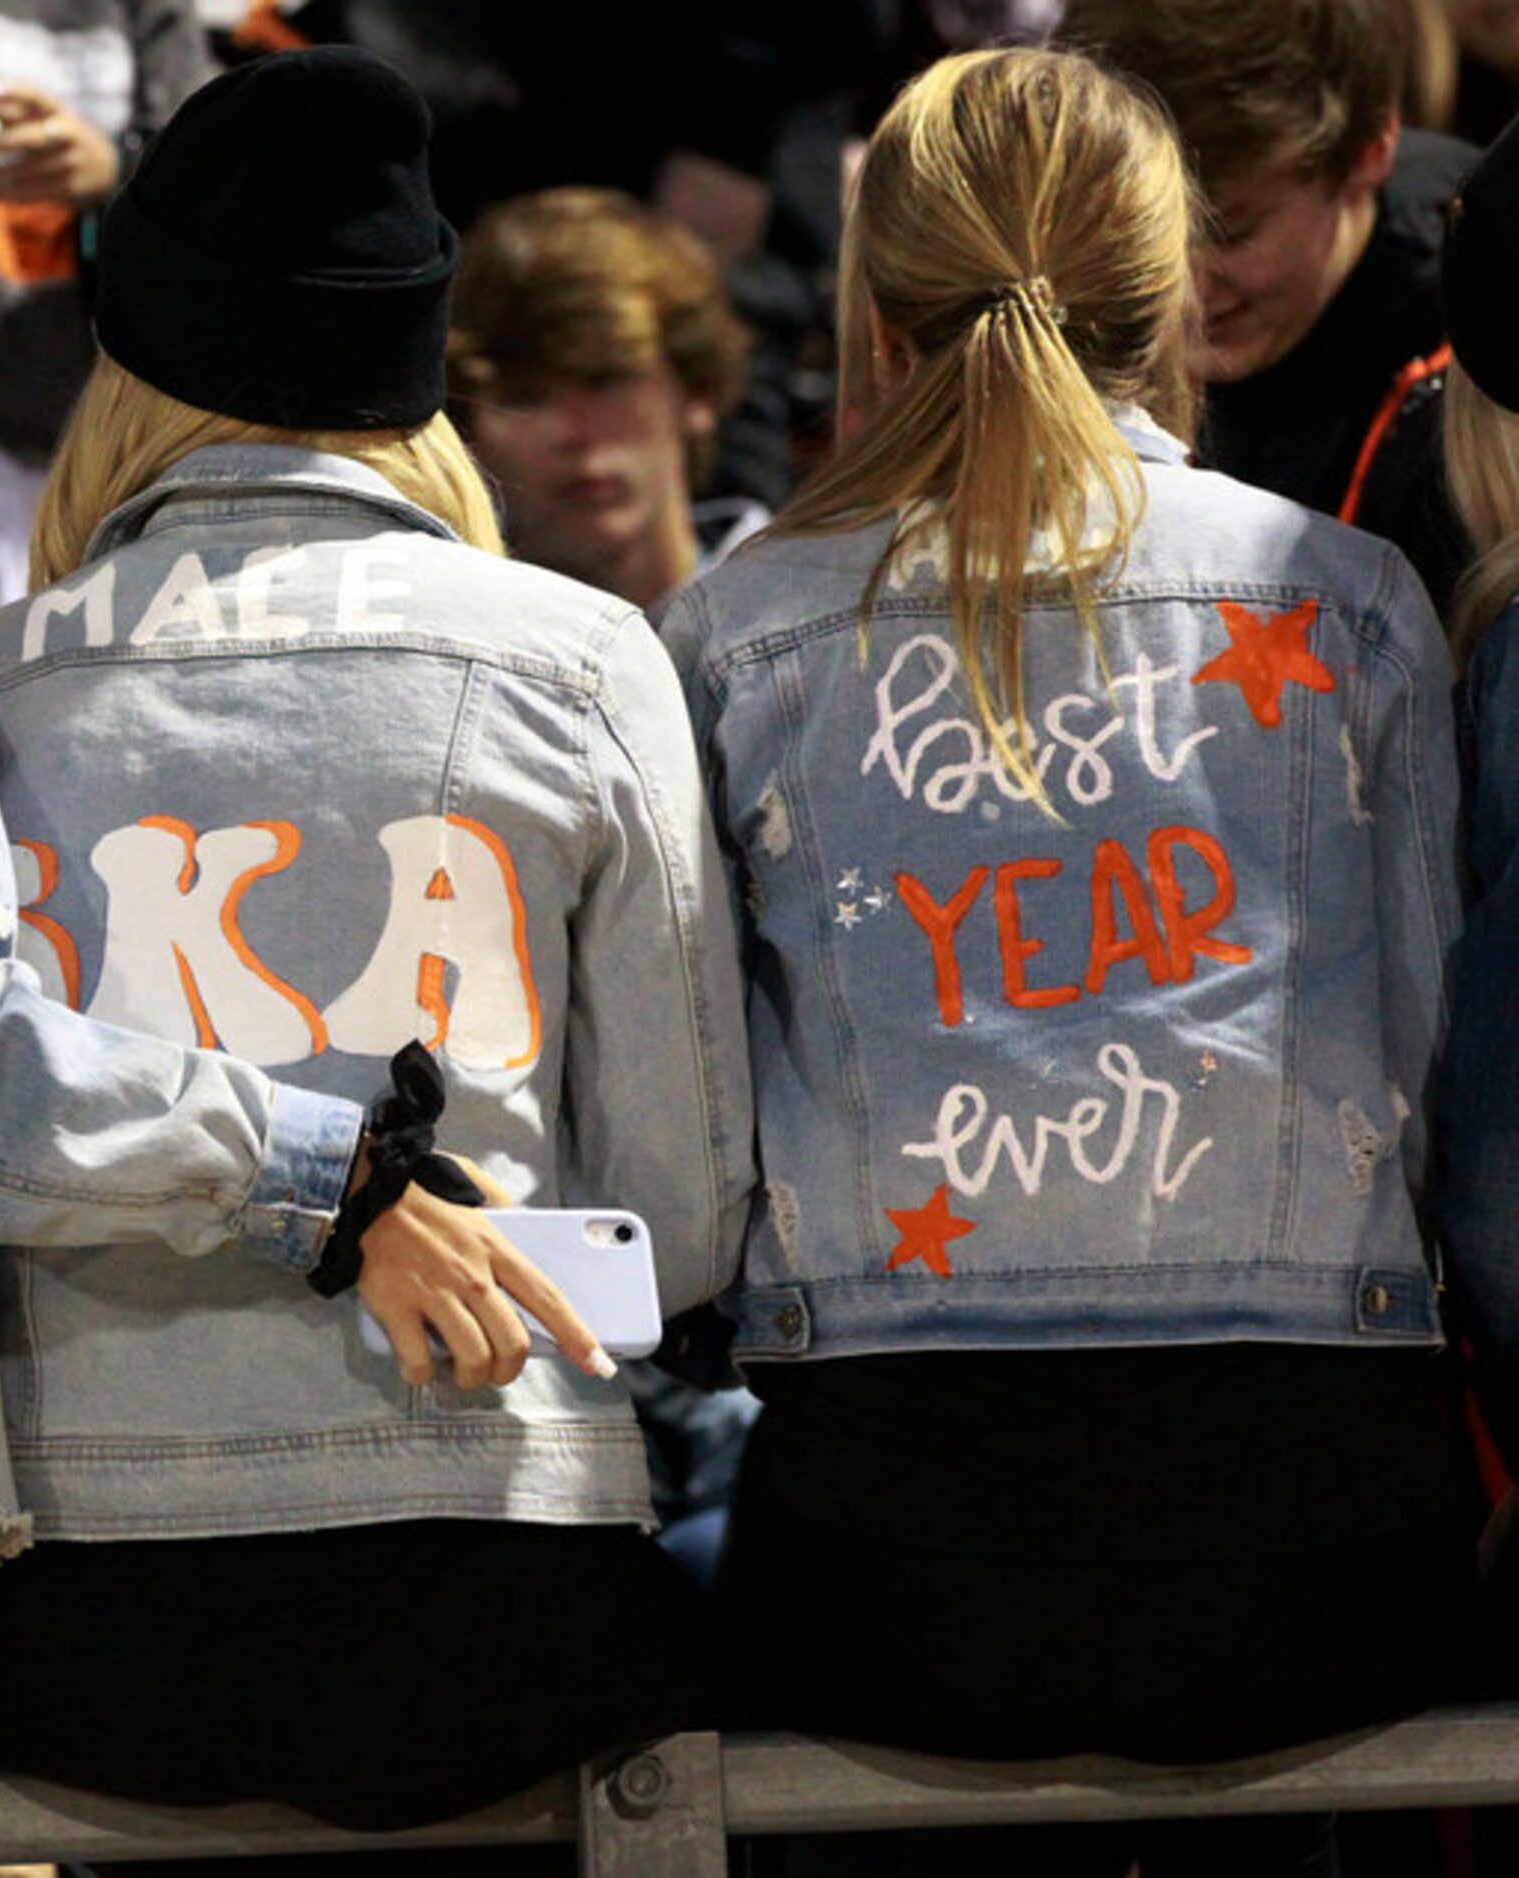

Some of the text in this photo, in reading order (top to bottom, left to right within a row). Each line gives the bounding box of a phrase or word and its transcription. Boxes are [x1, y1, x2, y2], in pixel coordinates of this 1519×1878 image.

[860, 634, 1219, 814] best
[894, 826, 1253, 1027] YEAR
[901, 1043, 1214, 1203] ever
